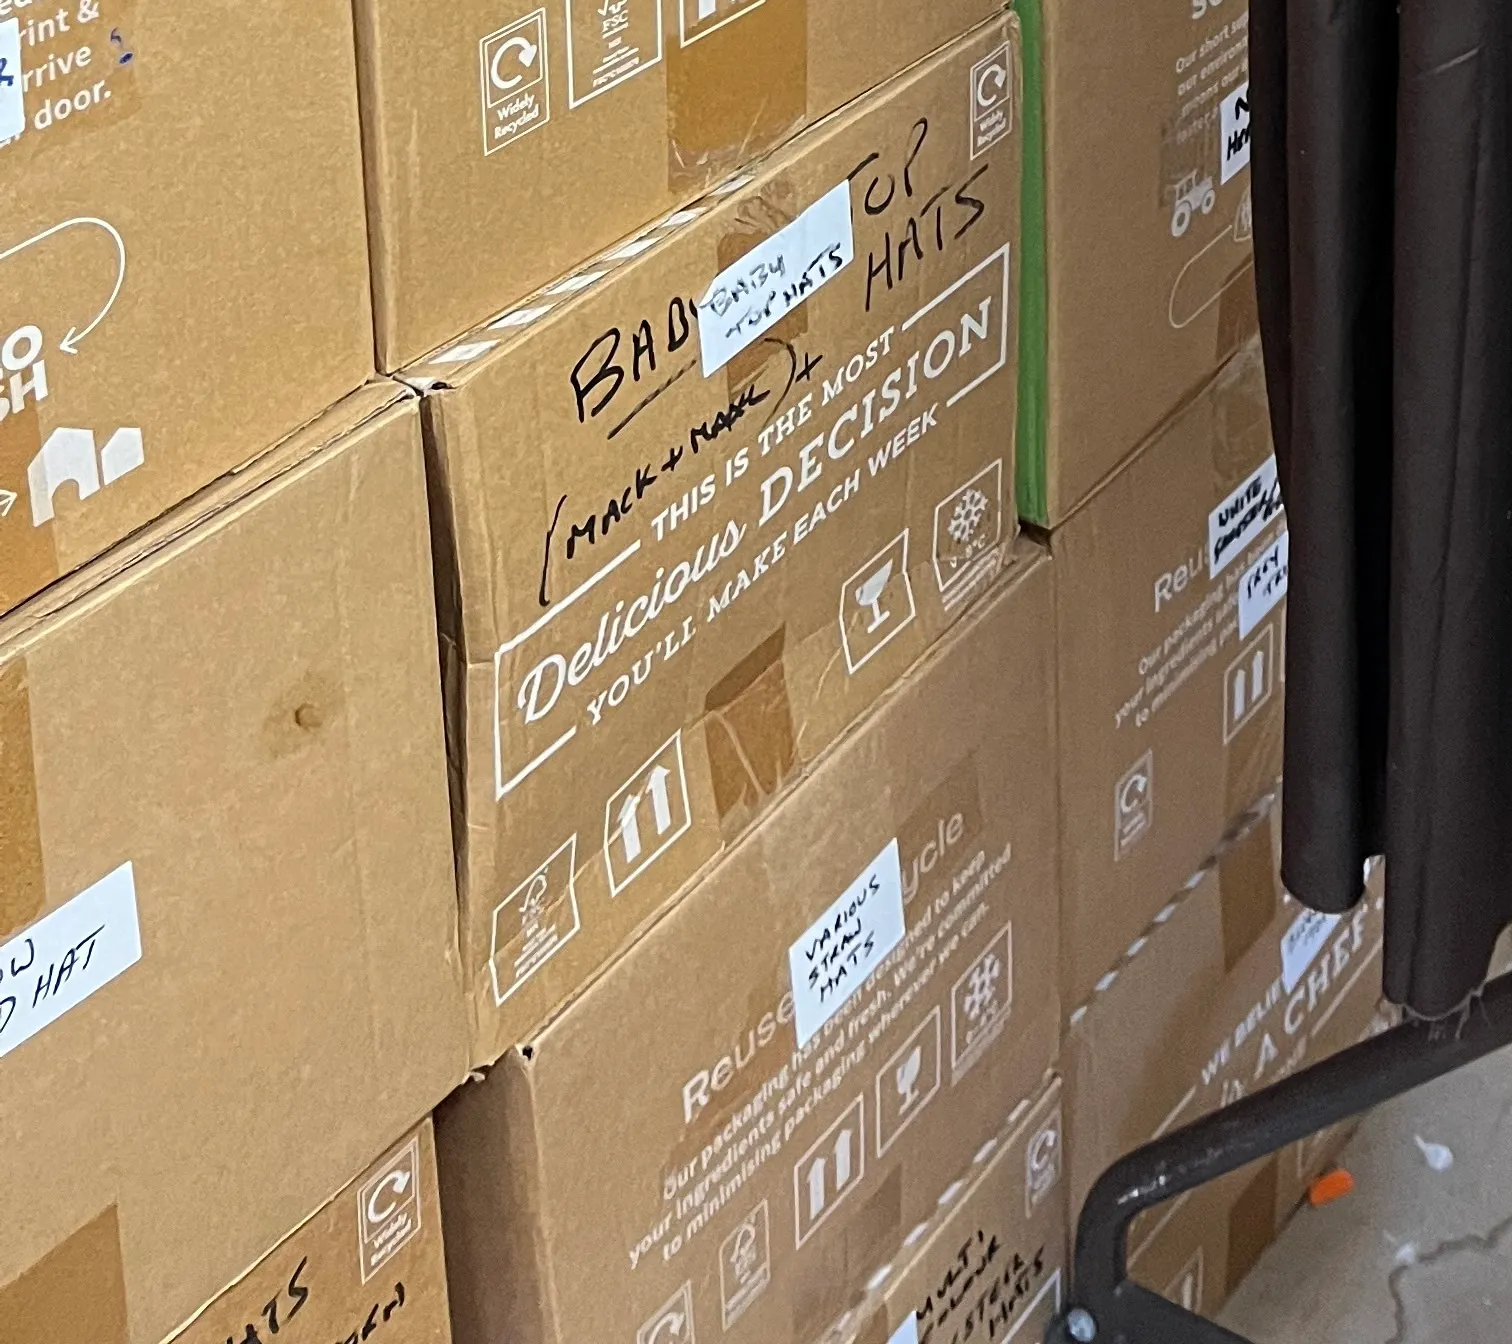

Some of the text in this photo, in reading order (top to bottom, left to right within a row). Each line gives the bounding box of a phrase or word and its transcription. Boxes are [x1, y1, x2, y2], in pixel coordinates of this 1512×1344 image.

[34, 80, 111, 130] door.
[495, 105, 539, 139] Recycled
[498, 93, 535, 121] Widely
[865, 163, 989, 311] HATS
[570, 295, 700, 423] BAB
[651, 325, 895, 542] THIS IS THE MOST
[517, 296, 993, 725] Delicious DECISION
[587, 410, 940, 726] YOU'LL MAKE EACH WEEK
[32, 923, 105, 1008] HAT
[805, 873, 880, 961] VARIOUS
[808, 916, 862, 989] STRAW
[820, 930, 875, 1003] HATS
[682, 991, 794, 1124] Reuse
[629, 1212, 672, 1270] your
[676, 1110, 775, 1219] ingredients
[663, 1234, 683, 1261] to
[686, 1131, 782, 1241] minimising
[785, 1040, 865, 1141] packaging
[664, 1157, 698, 1201] Our
[702, 1064, 788, 1169] packaging
